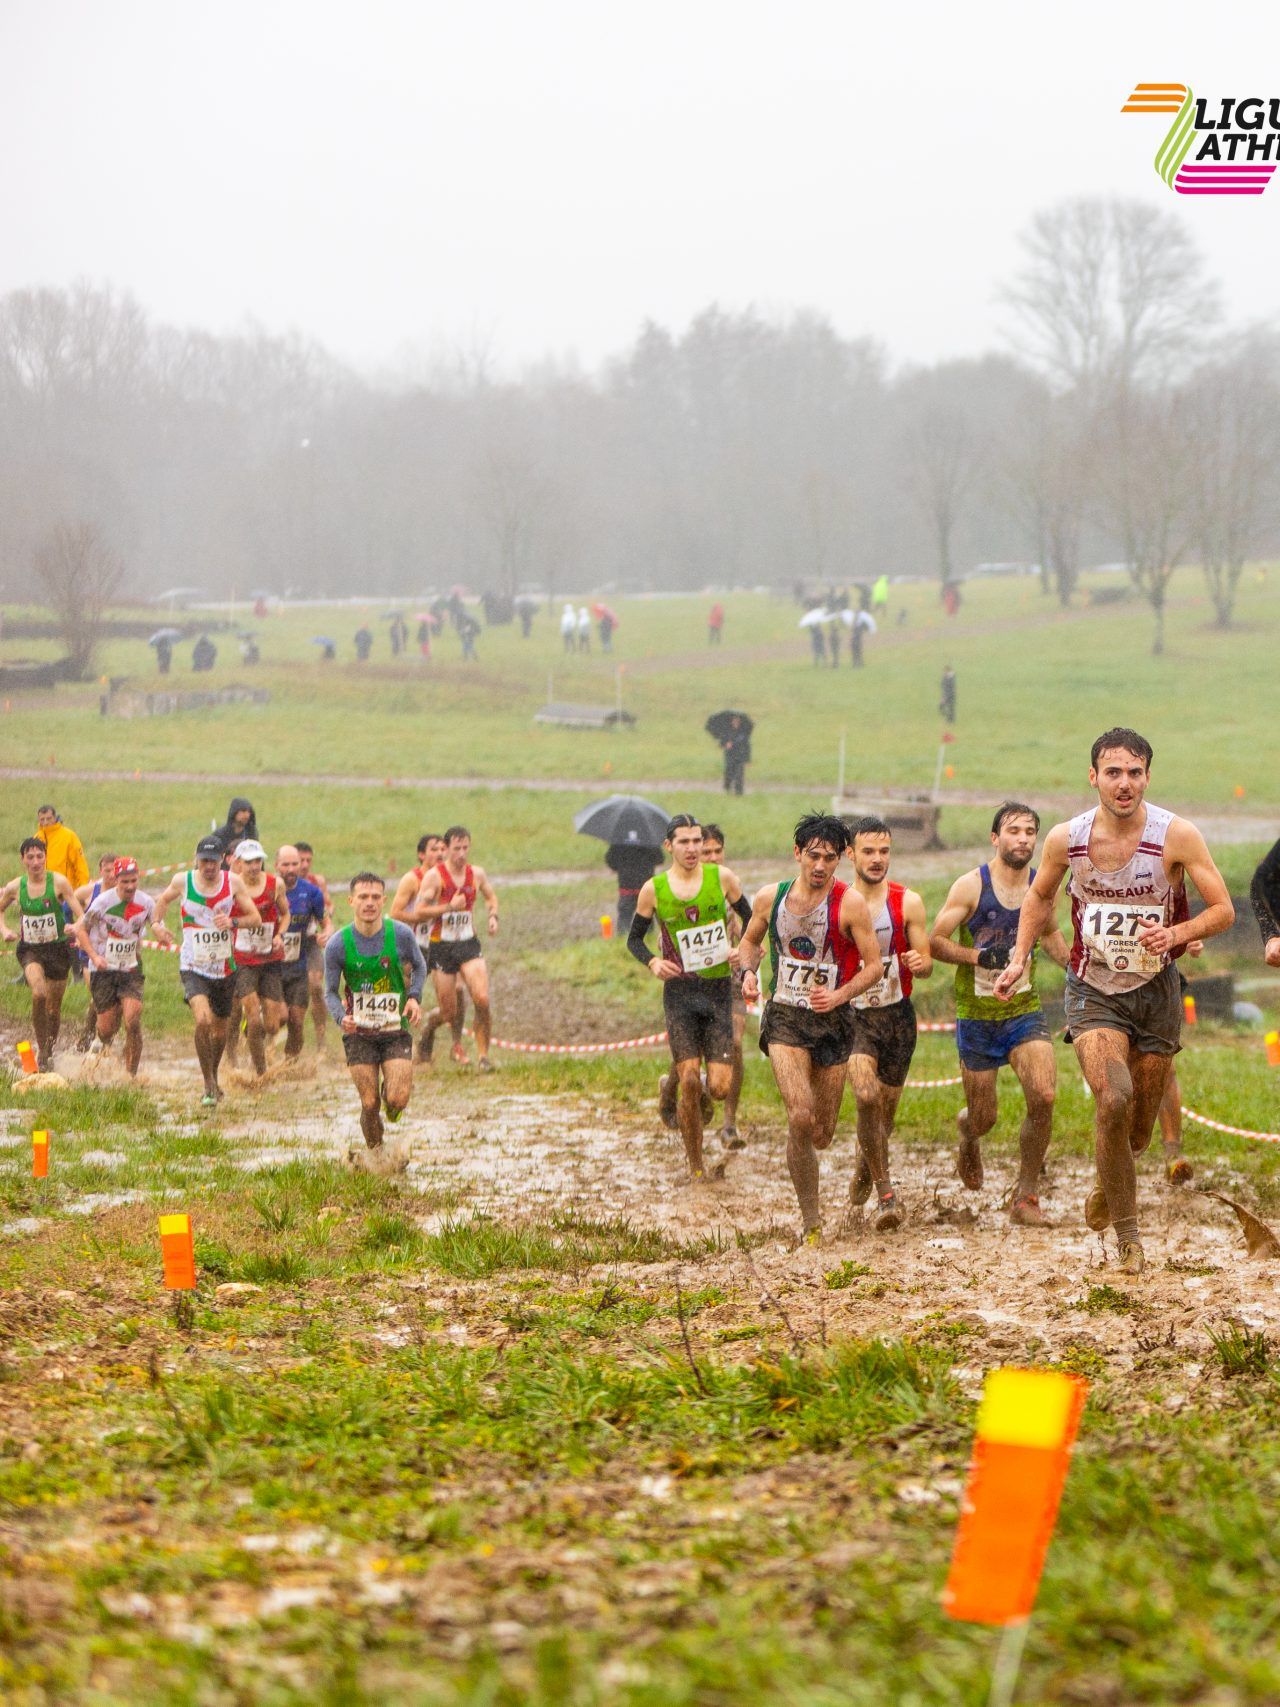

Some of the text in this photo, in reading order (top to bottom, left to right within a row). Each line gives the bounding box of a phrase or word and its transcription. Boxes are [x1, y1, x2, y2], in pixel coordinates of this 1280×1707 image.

[24, 916, 55, 929] 1478
[193, 931, 229, 945] 1096
[681, 926, 724, 950] 1472
[786, 963, 830, 986] 775
[355, 996, 398, 1012] 1449
